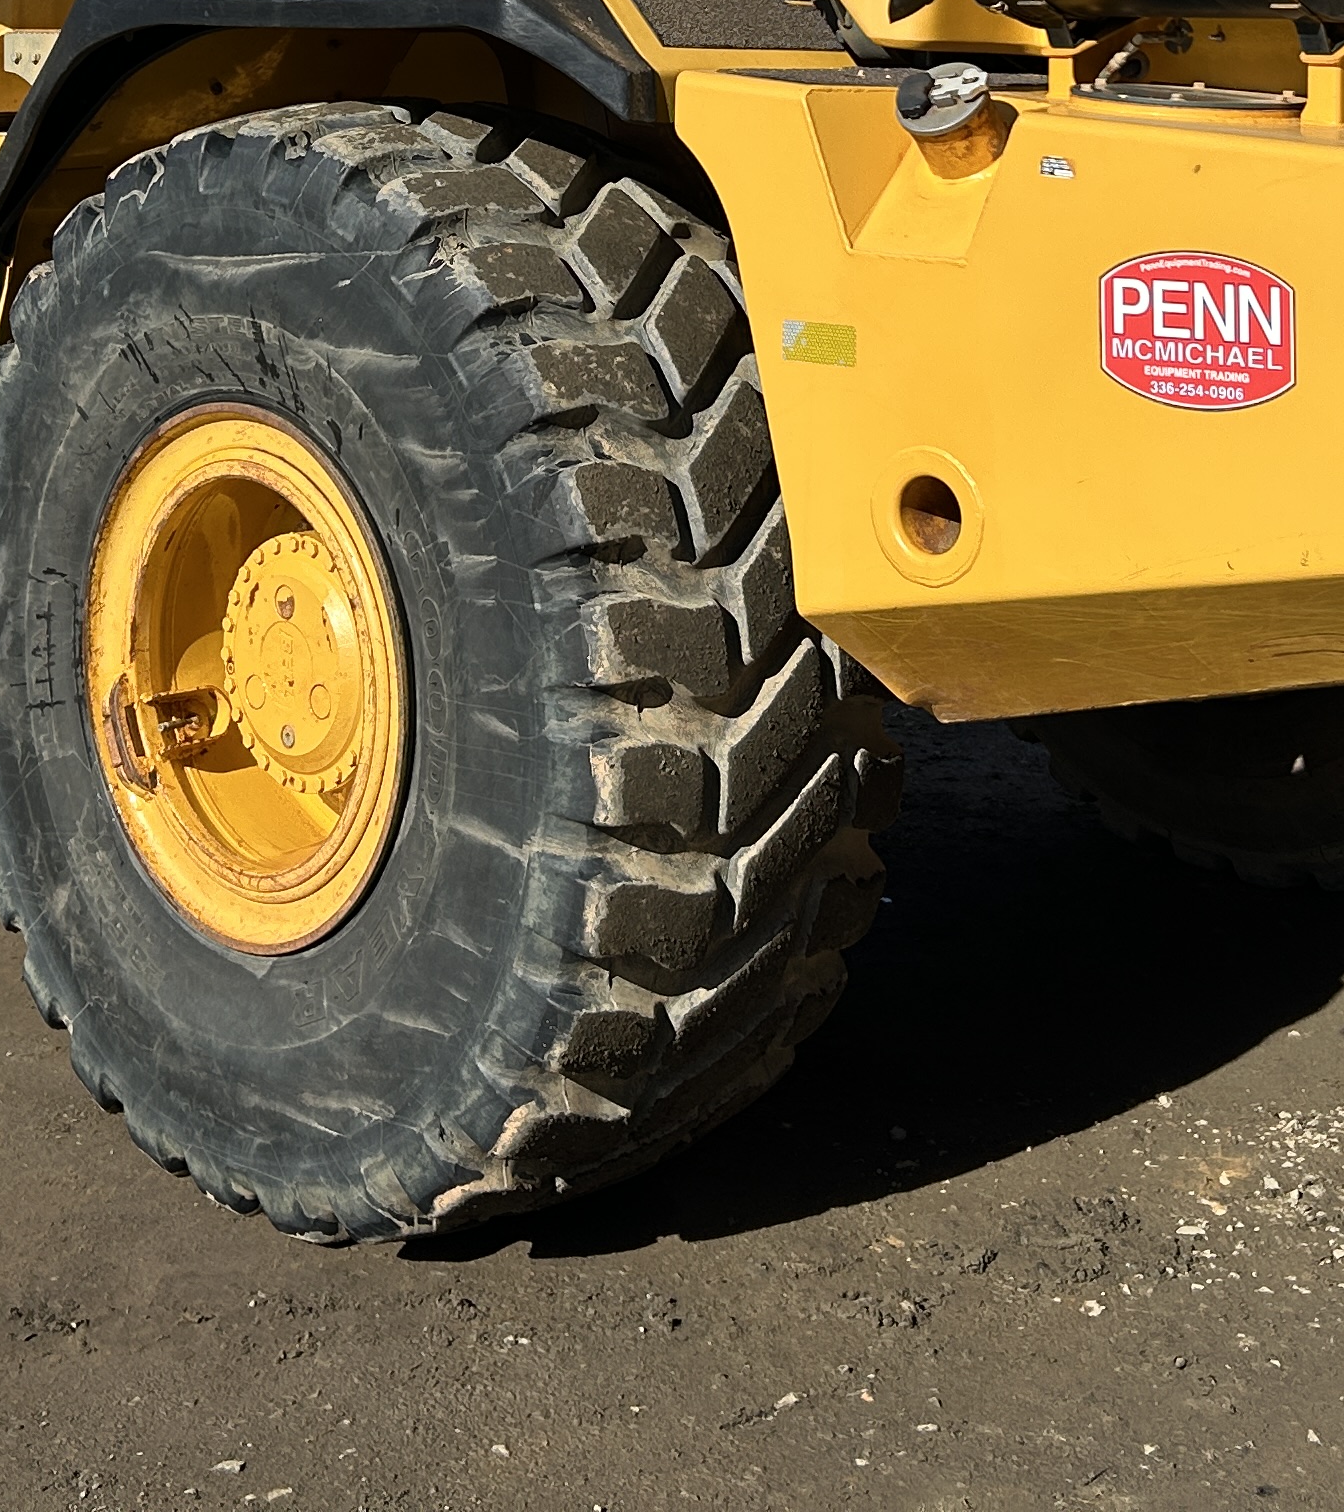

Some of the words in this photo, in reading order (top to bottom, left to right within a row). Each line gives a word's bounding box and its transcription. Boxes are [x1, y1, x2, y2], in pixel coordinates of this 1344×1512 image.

[1112, 277, 1282, 346] PENN
[1112, 338, 1283, 370] MCMICHAEL
[1144, 365, 1202, 379] EQUIPMENT
[1203, 369, 1250, 384] TRADING
[1150, 380, 1244, 400] 336-254-0906
